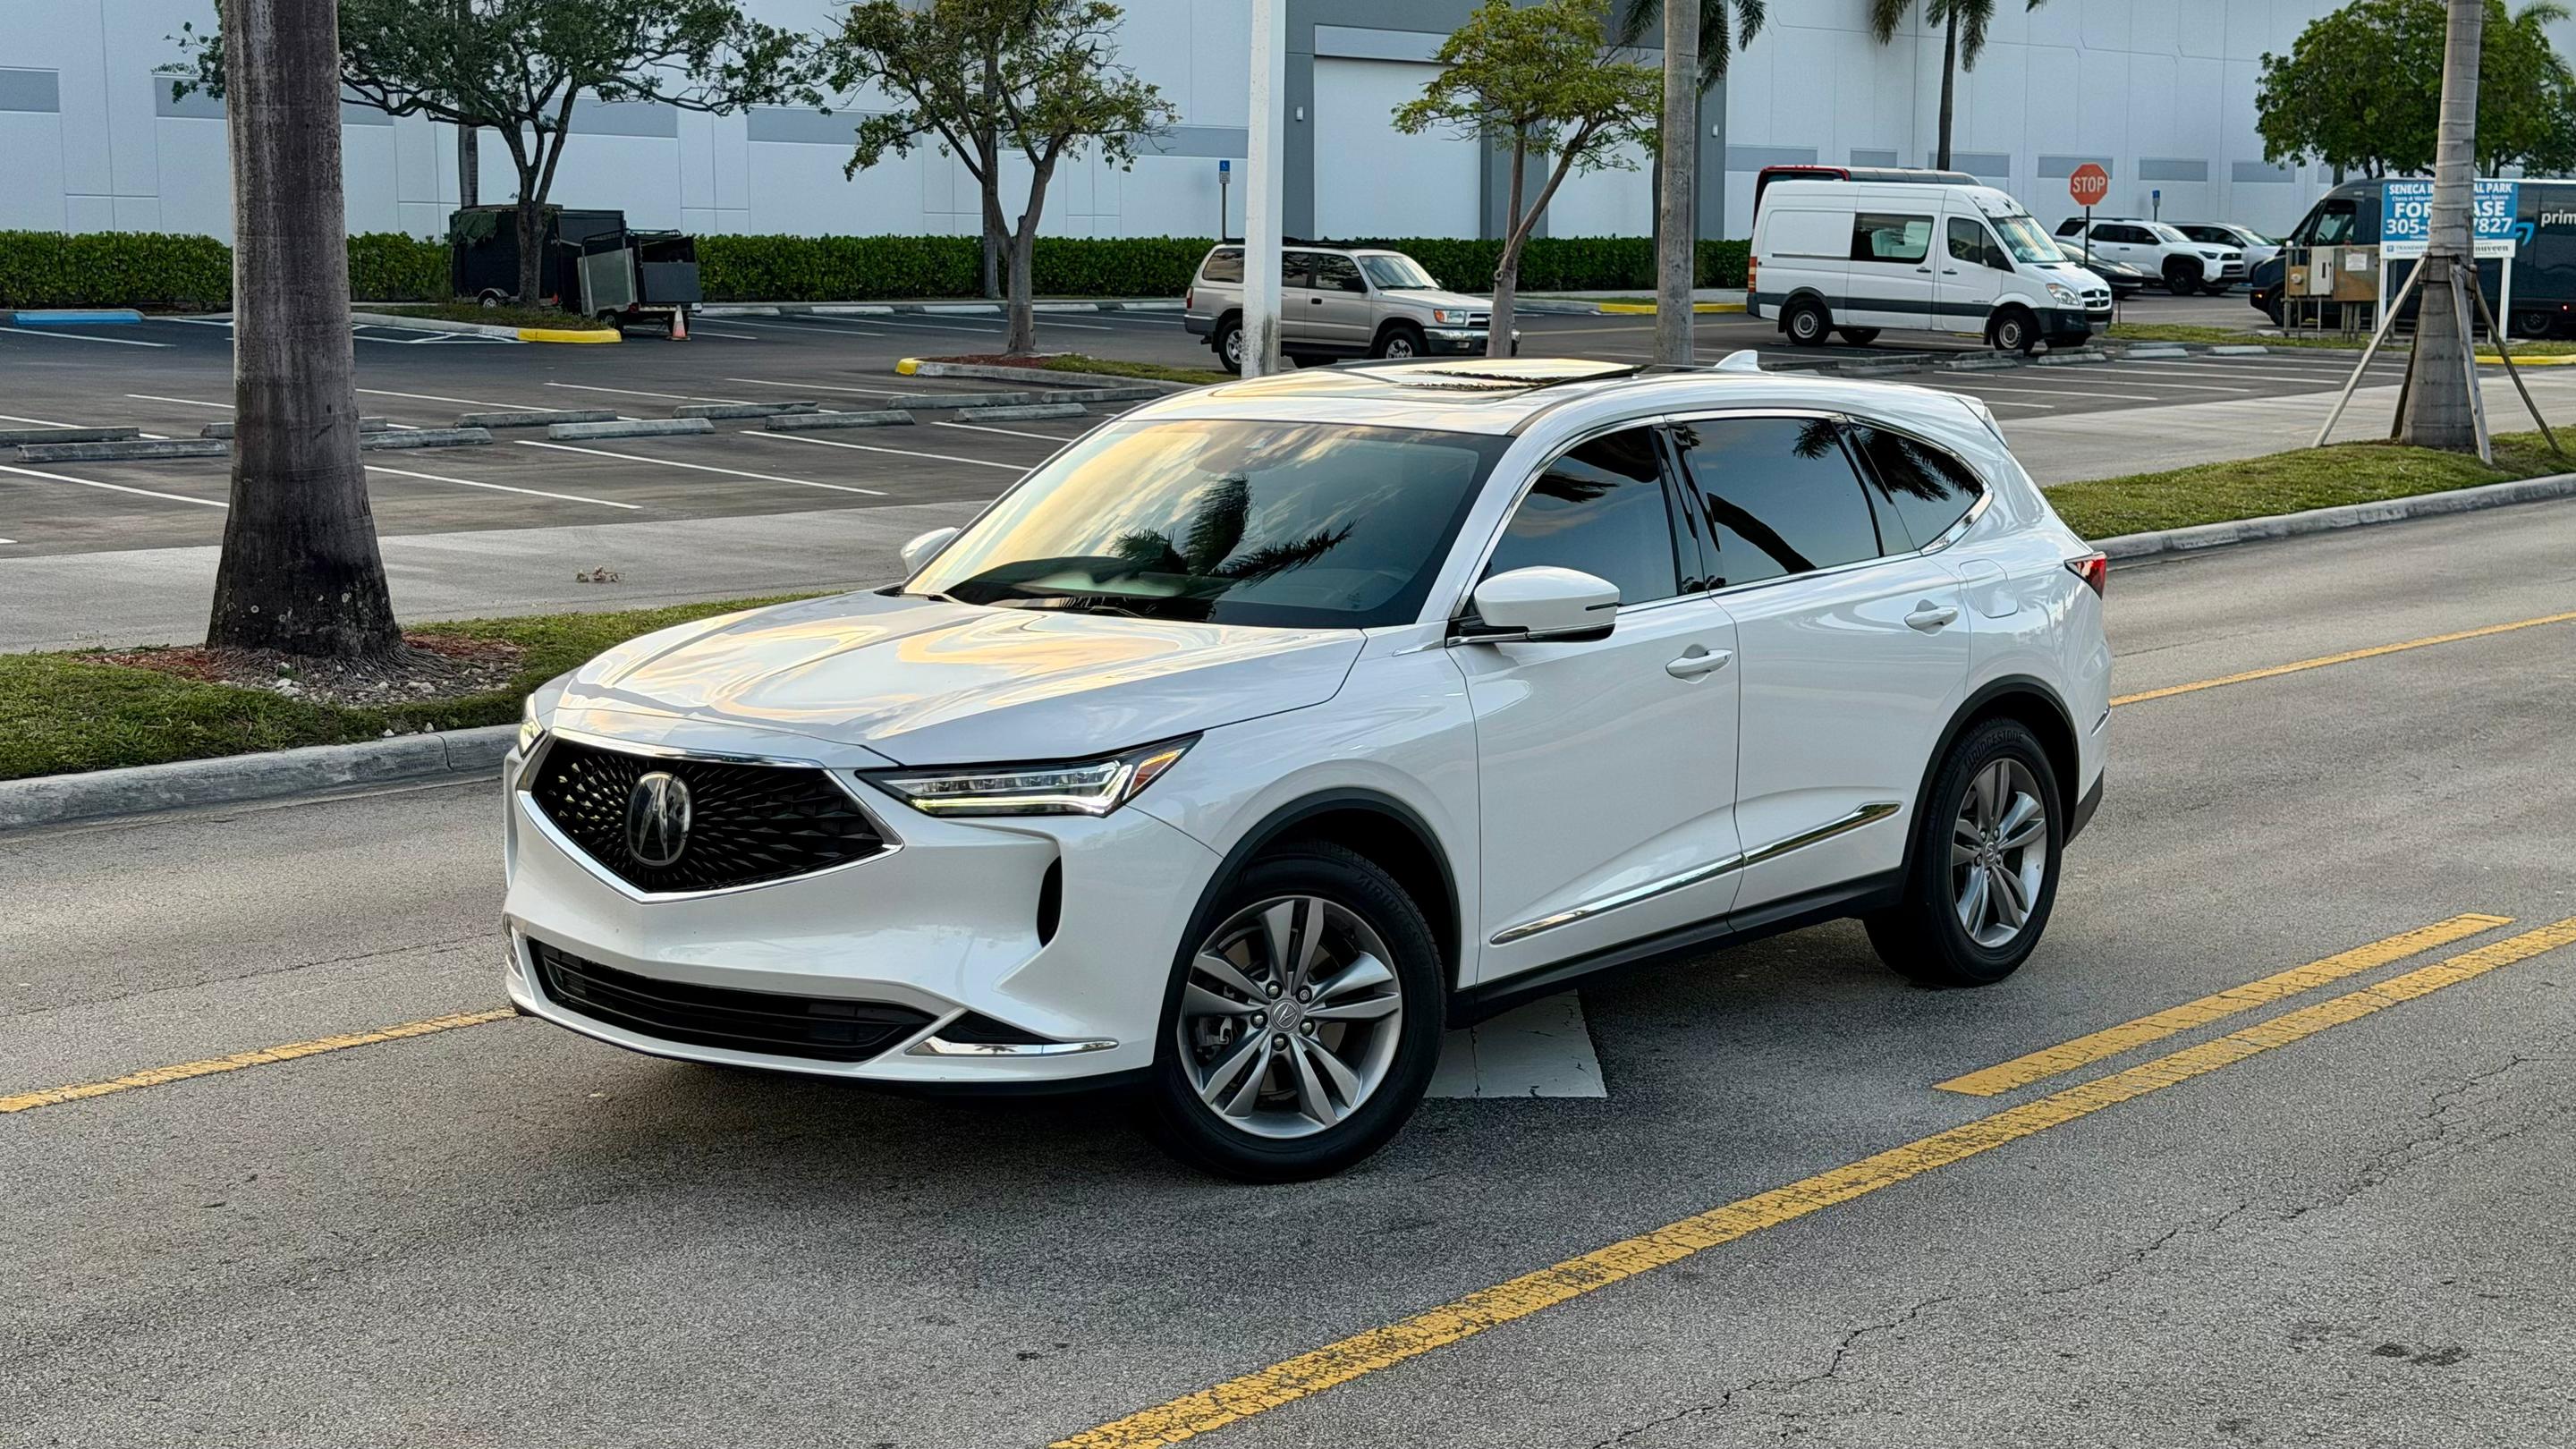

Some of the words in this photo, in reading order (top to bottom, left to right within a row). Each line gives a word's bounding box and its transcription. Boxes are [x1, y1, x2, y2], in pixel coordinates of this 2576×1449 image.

[2072, 176, 2106, 193] STOP
[2389, 183, 2426, 195] SENECA
[2487, 182, 2512, 193] PARK
